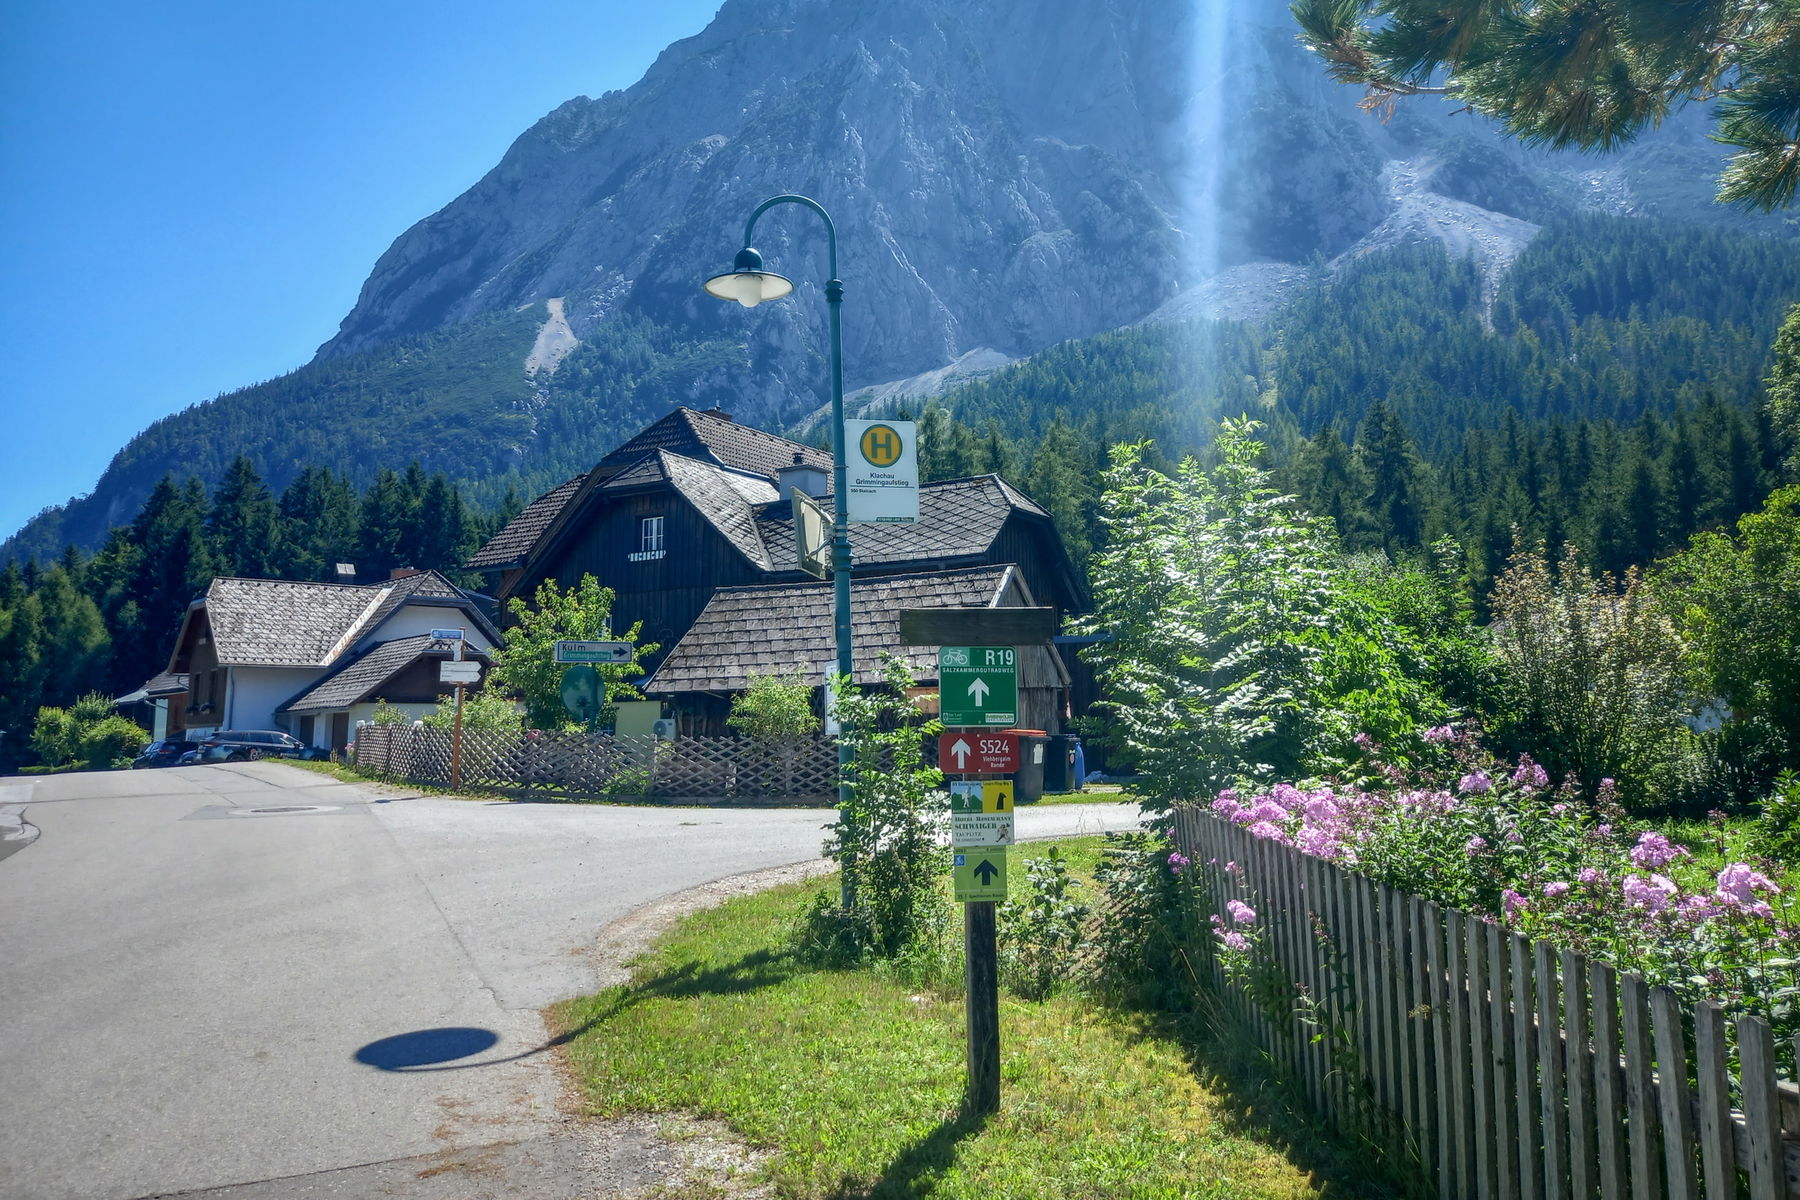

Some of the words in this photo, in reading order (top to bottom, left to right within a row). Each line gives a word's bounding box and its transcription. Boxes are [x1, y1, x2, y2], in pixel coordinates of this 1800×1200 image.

[562, 643, 586, 652] Kulm
[979, 739, 1010, 754] S524
[954, 822, 997, 831] SCHWAIGER
